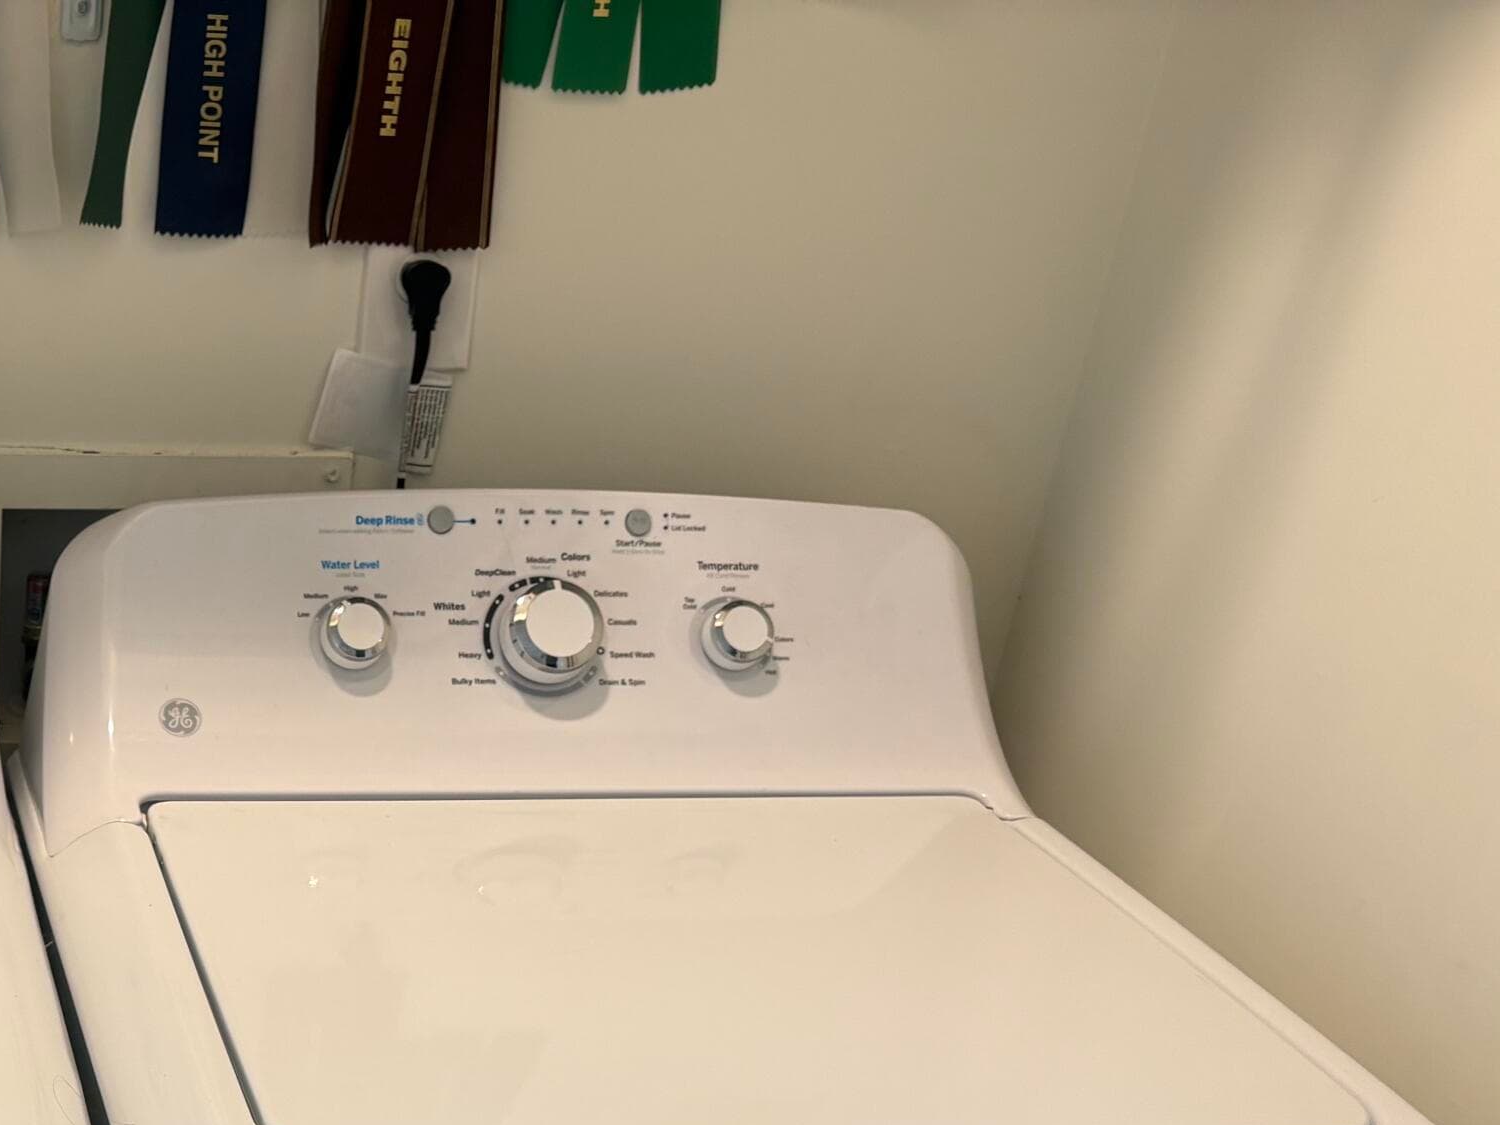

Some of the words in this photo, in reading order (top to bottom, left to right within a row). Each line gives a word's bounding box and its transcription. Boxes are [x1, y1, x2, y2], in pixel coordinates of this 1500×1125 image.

[203, 14, 229, 77] HIGH
[379, 18, 412, 137] EIGHTH
[198, 85, 224, 163] POINT
[355, 515, 383, 527] Deep
[385, 515, 415, 525] Rinse
[561, 552, 591, 561] Colors
[321, 560, 352, 569] Water
[354, 560, 380, 569] Level
[697, 560, 759, 572] Temperature
[567, 569, 586, 578] Light
[433, 602, 466, 610] Whites
